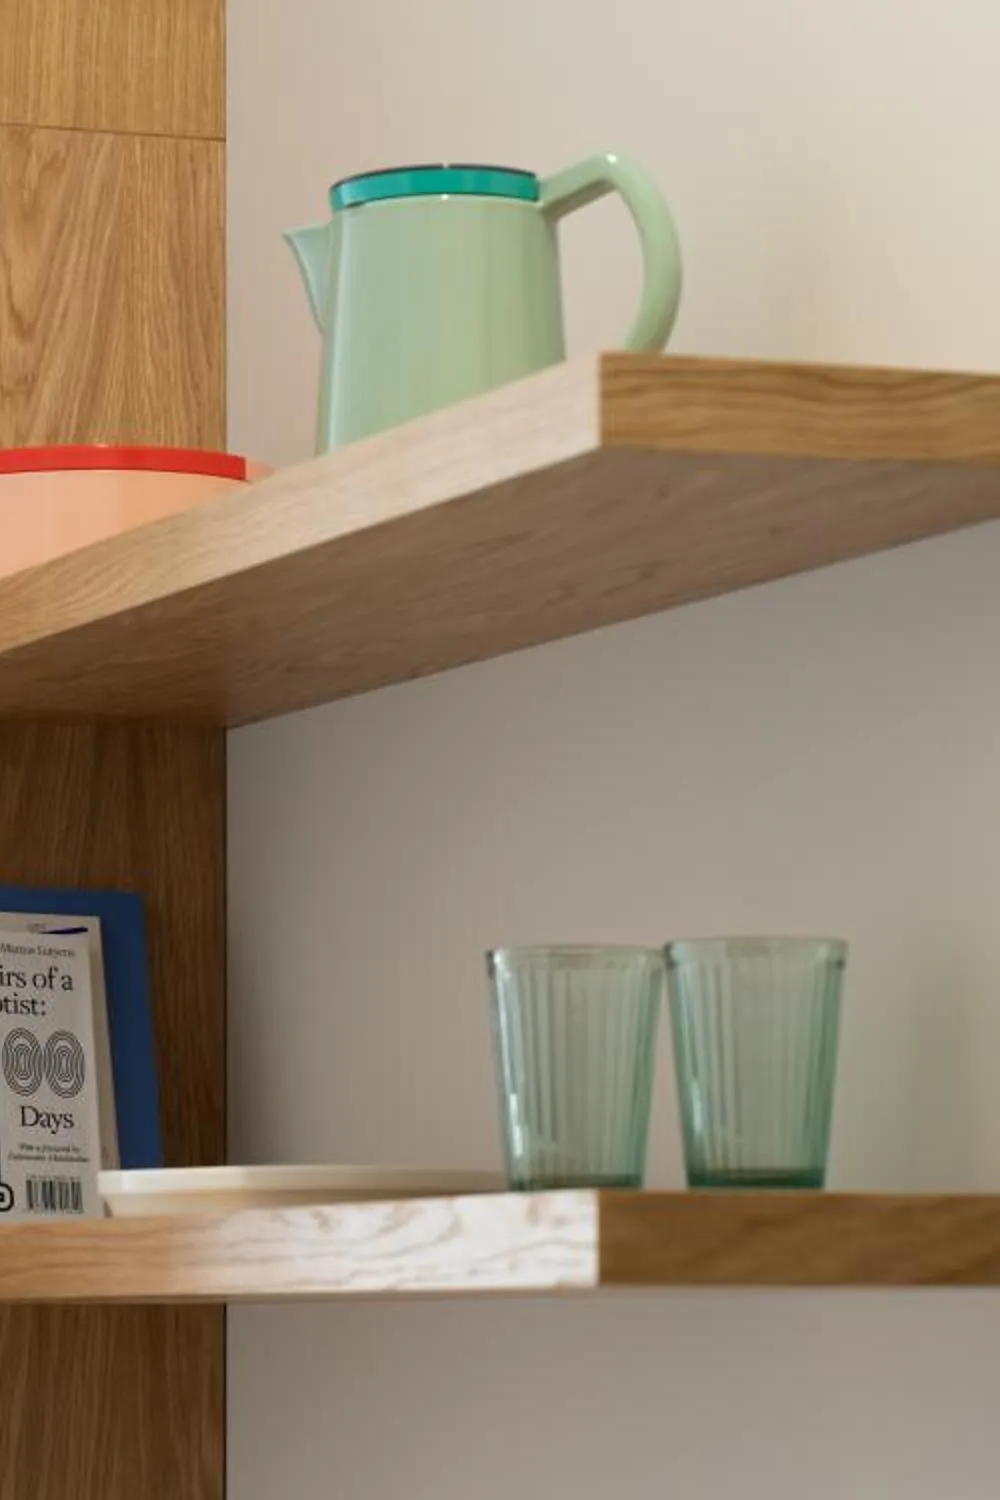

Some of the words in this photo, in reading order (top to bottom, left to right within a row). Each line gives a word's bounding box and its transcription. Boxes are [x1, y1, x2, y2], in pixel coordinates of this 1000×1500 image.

[32, 965, 59, 990] of
[61, 973, 73, 991] a
[20, 1105, 75, 1134] Days
